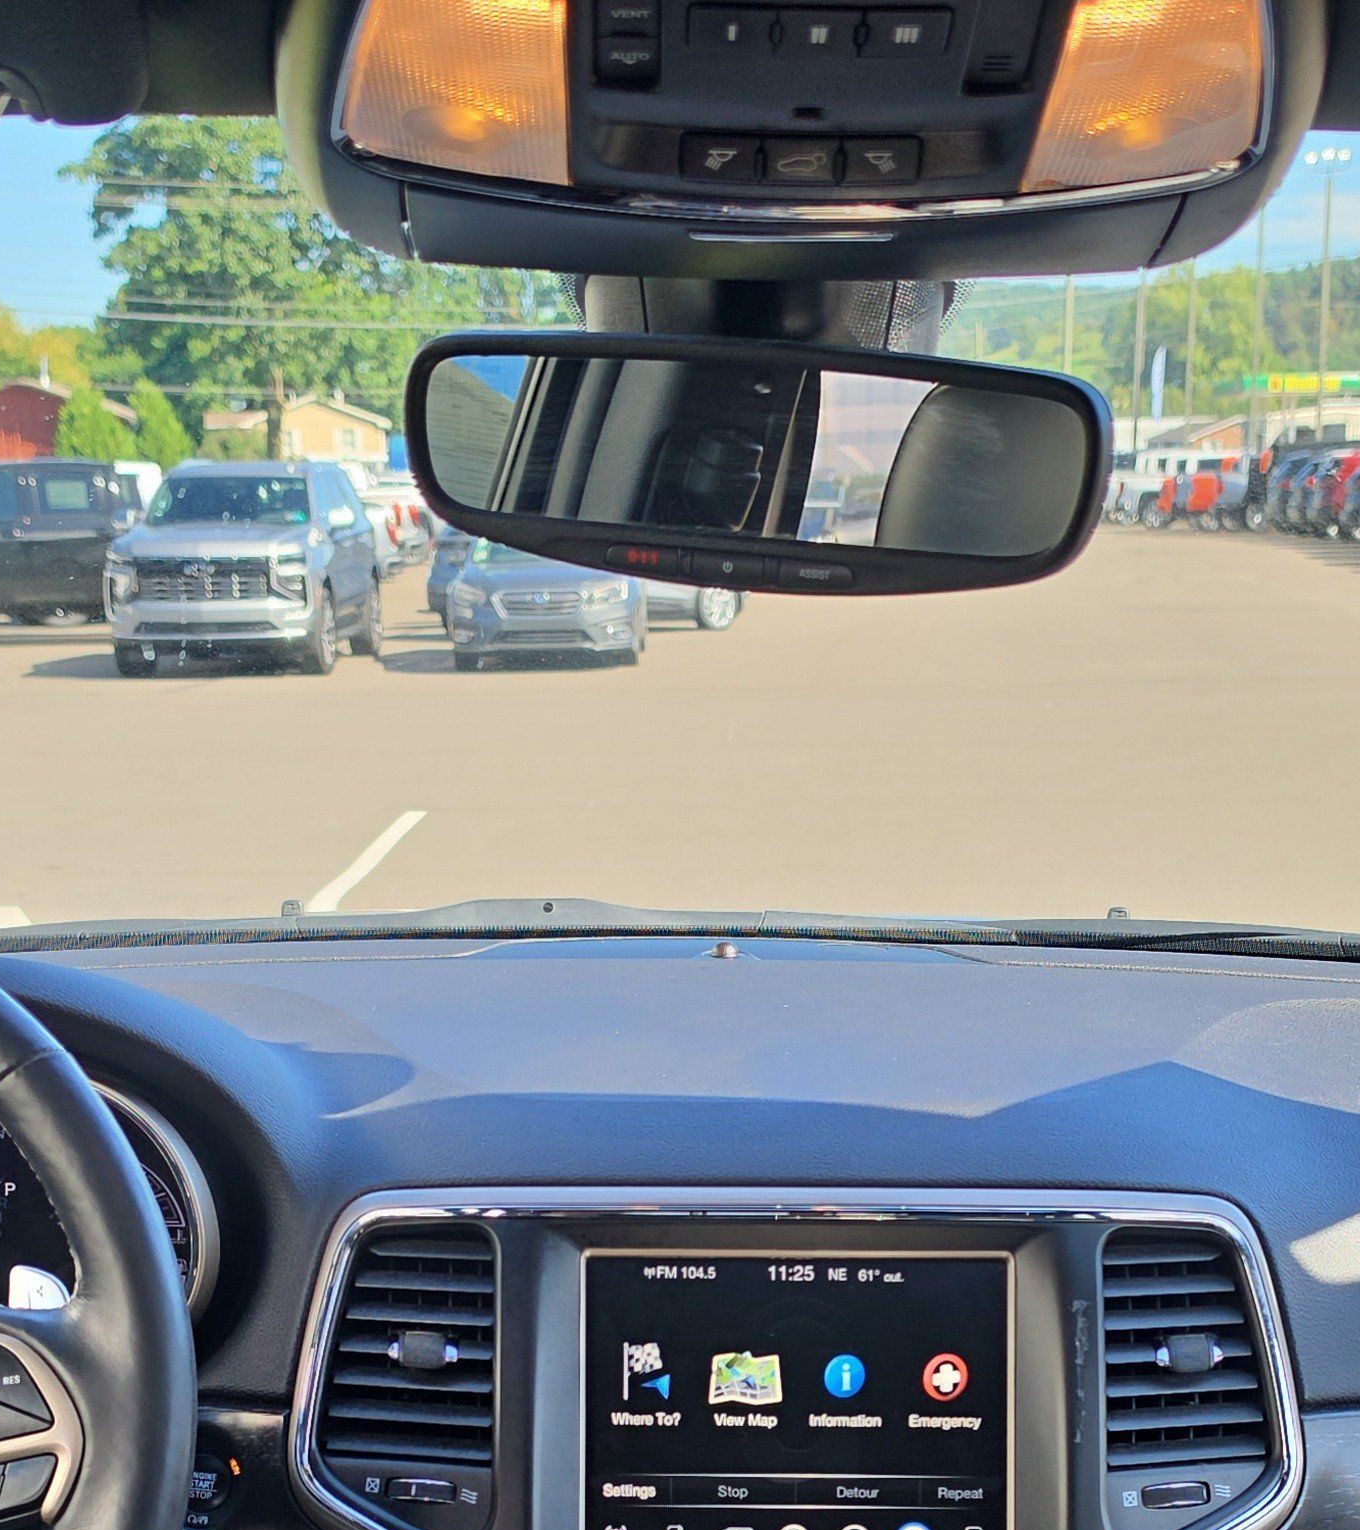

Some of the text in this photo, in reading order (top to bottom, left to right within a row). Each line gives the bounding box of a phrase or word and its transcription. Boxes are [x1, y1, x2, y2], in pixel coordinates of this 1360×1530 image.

[611, 8, 649, 18] VENT
[611, 51, 649, 61] AUTO
[798, 568, 830, 580] ASSIST
[4, 1182, 17, 1197] P
[656, 1266, 717, 1281] FM 104.5
[767, 1265, 815, 1282] 11:25
[827, 1268, 848, 1282] NE
[857, 1268, 881, 1283] 61°
[2, 1374, 21, 1387] RES
[611, 1412, 682, 1427] Where To?
[713, 1413, 779, 1429] View Map
[809, 1413, 883, 1428] Information
[908, 1414, 983, 1431] Emergency
[188, 1490, 213, 1500] STOP
[602, 1483, 657, 1500] Settings
[717, 1485, 749, 1500] Stop
[836, 1486, 880, 1499] Detour
[937, 1486, 984, 1501] Repeat
